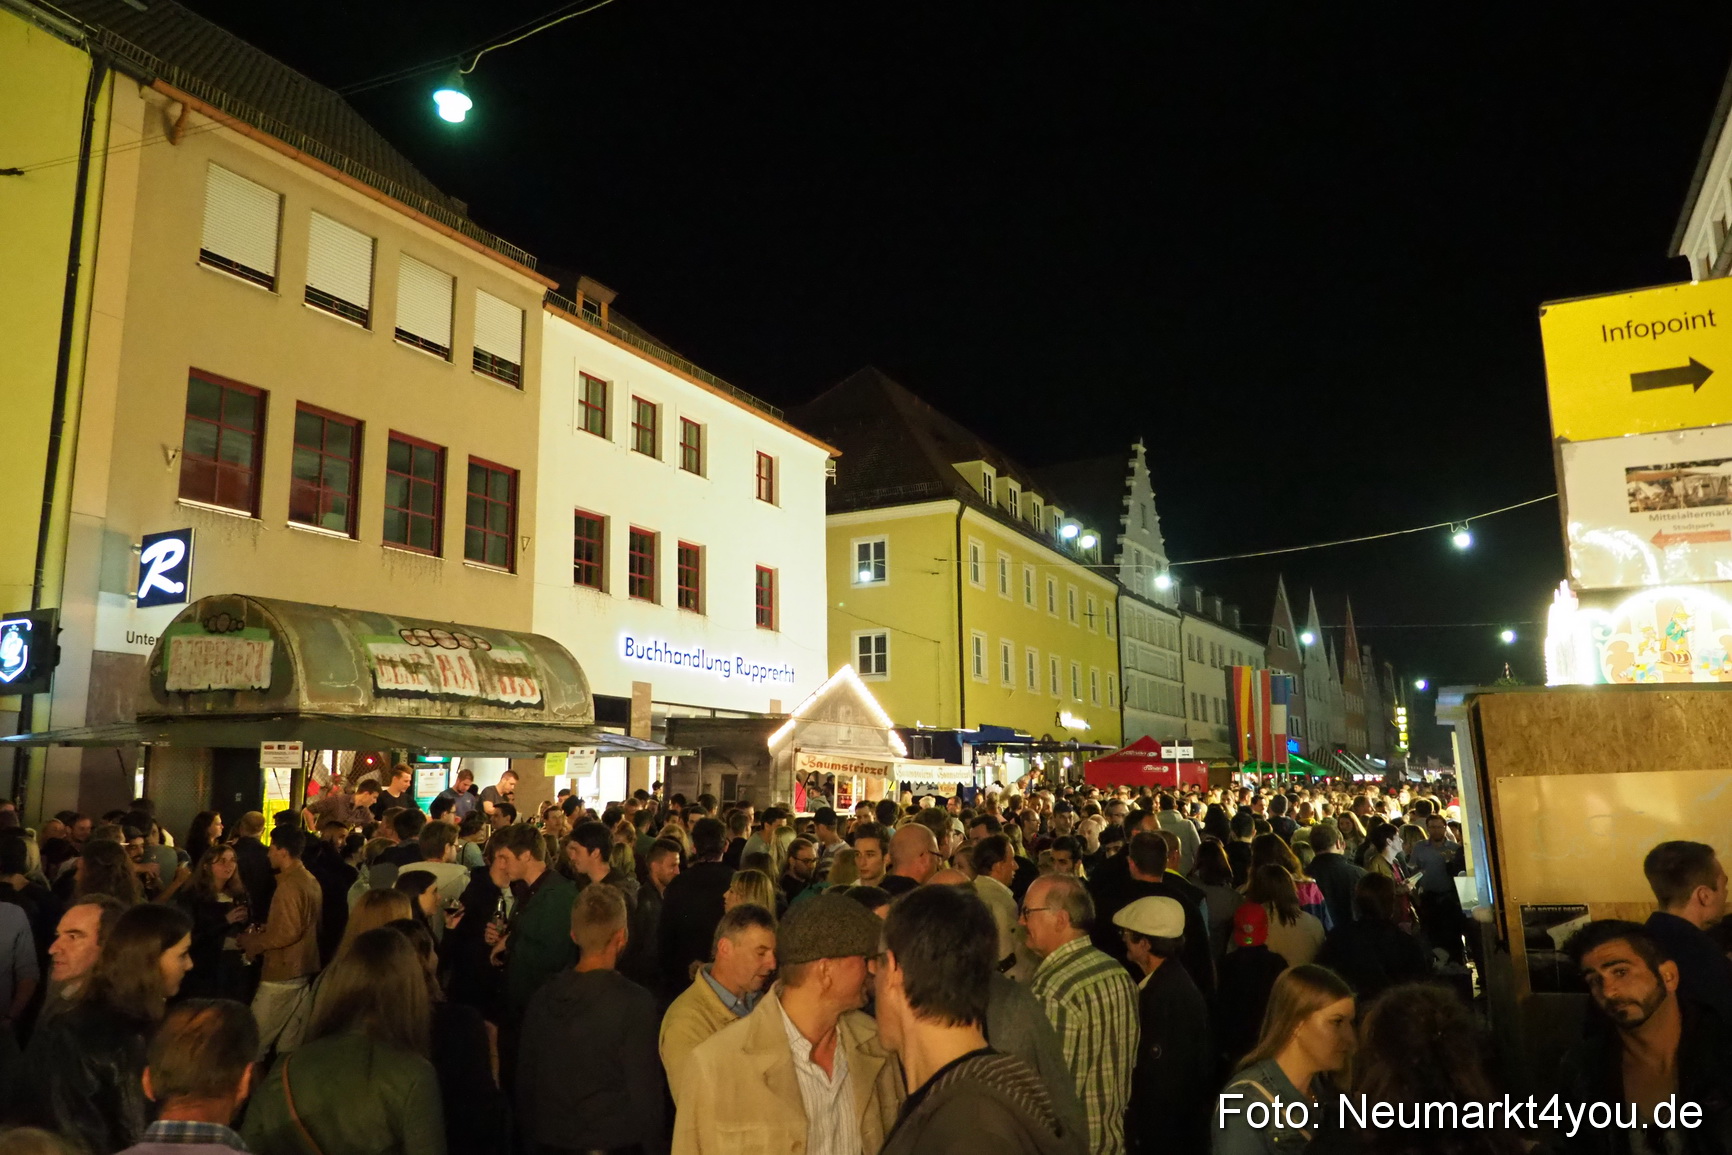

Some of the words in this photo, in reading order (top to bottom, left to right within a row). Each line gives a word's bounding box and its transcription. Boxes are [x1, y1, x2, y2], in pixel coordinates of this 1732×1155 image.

[1601, 308, 1718, 343] Infopoint
[624, 636, 731, 678] Buchhandlung
[736, 656, 796, 684] Rupprecht
[1396, 706, 1409, 750] HOTEL
[801, 753, 889, 777] Baumstriezel
